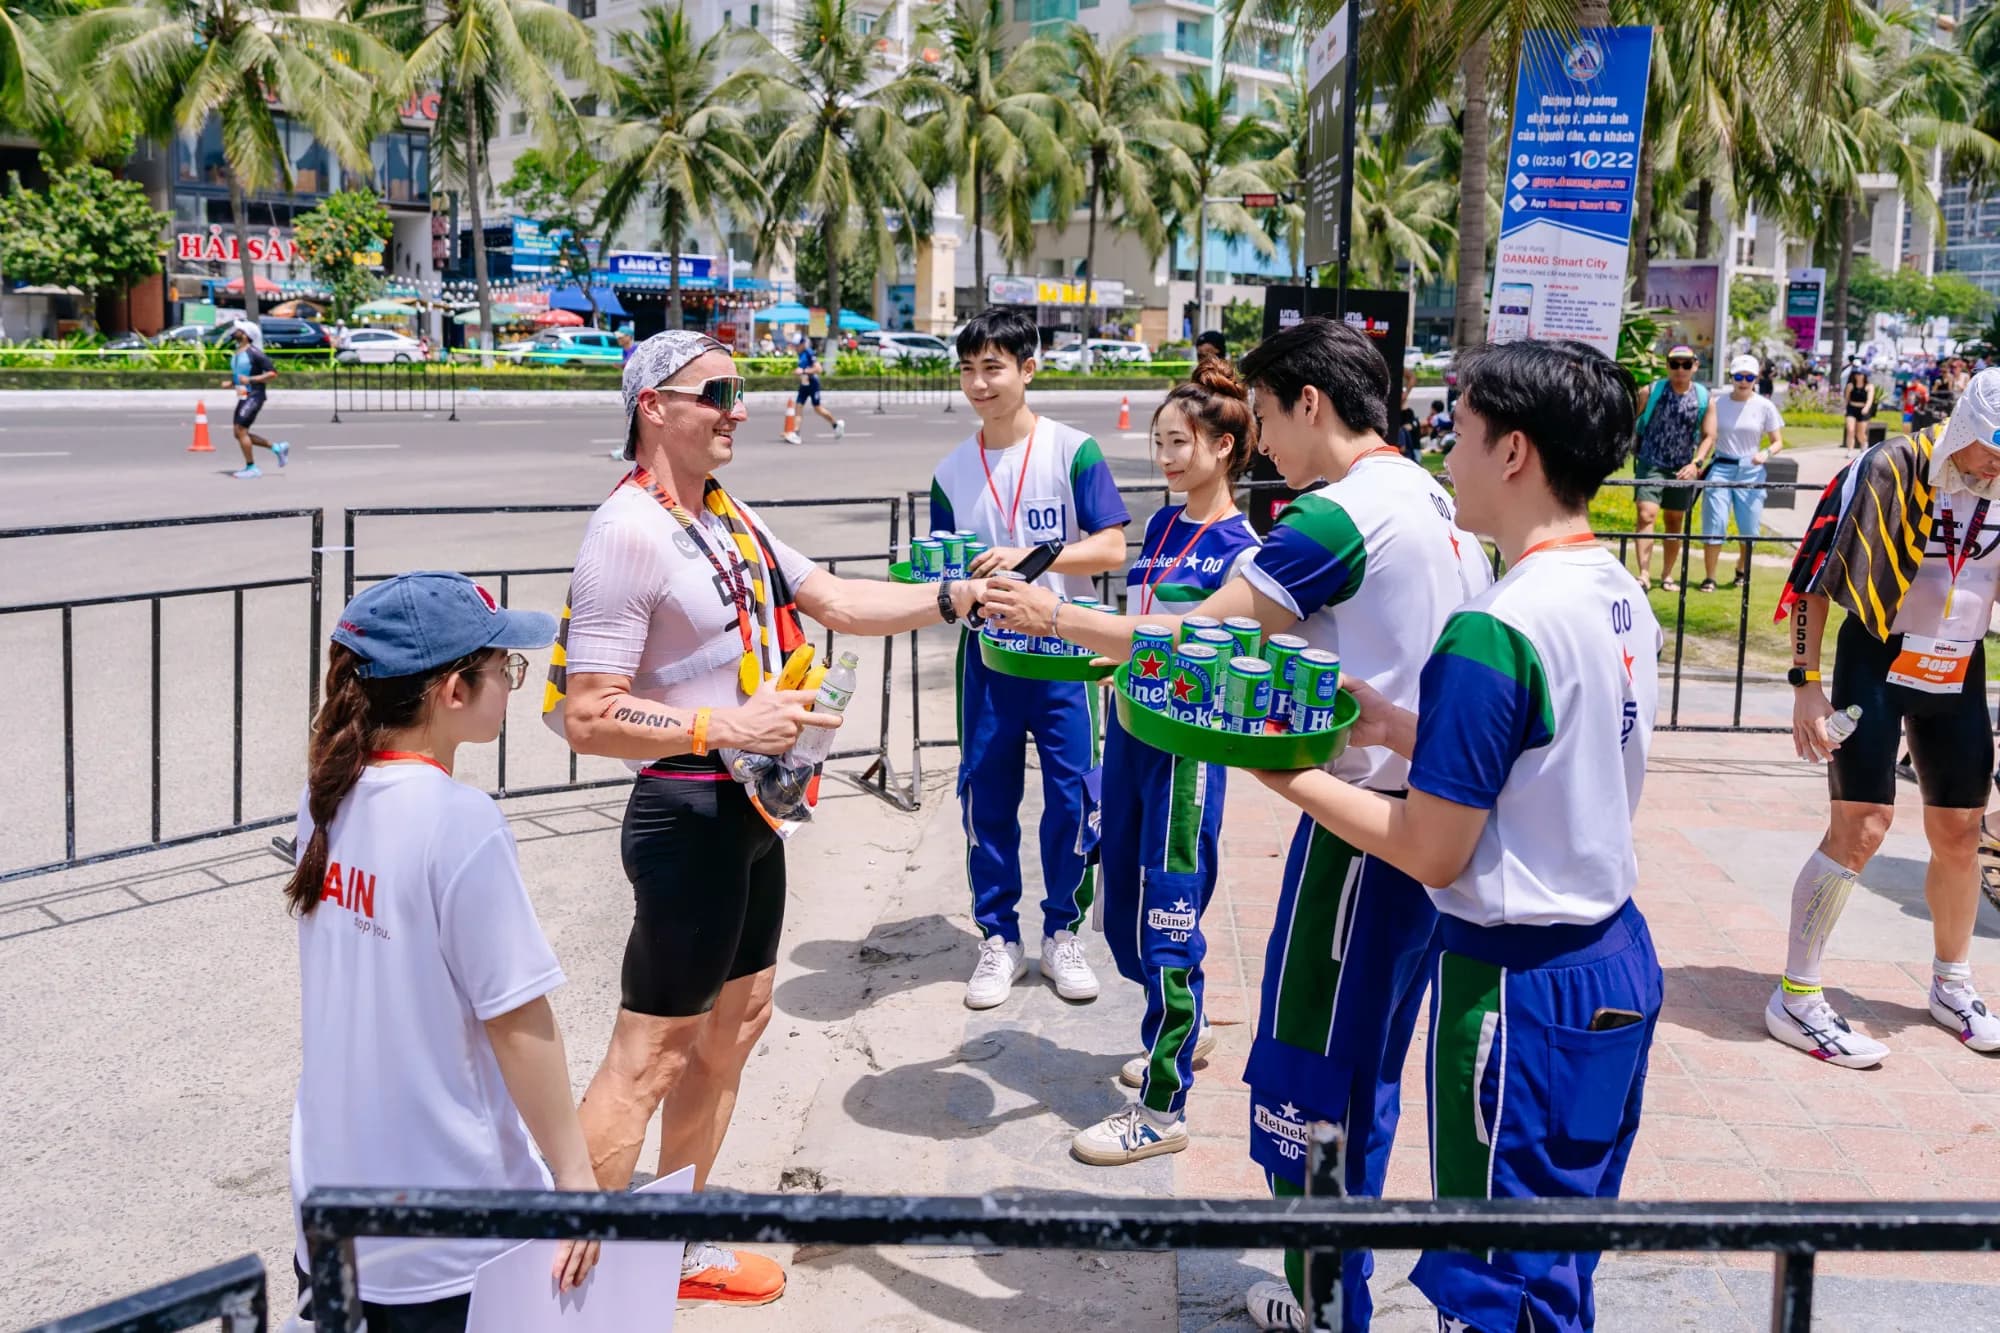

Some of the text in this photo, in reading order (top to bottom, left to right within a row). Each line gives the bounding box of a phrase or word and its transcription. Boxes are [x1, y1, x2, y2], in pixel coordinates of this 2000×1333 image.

[1532, 155, 1568, 168] (0236)
[1530, 198, 1547, 209] App
[1502, 253, 1609, 271] DANANG Smart City
[1027, 508, 1057, 530] 0.0
[1796, 600, 1808, 655] 3059
[1280, 1140, 1299, 1160] 0.0
